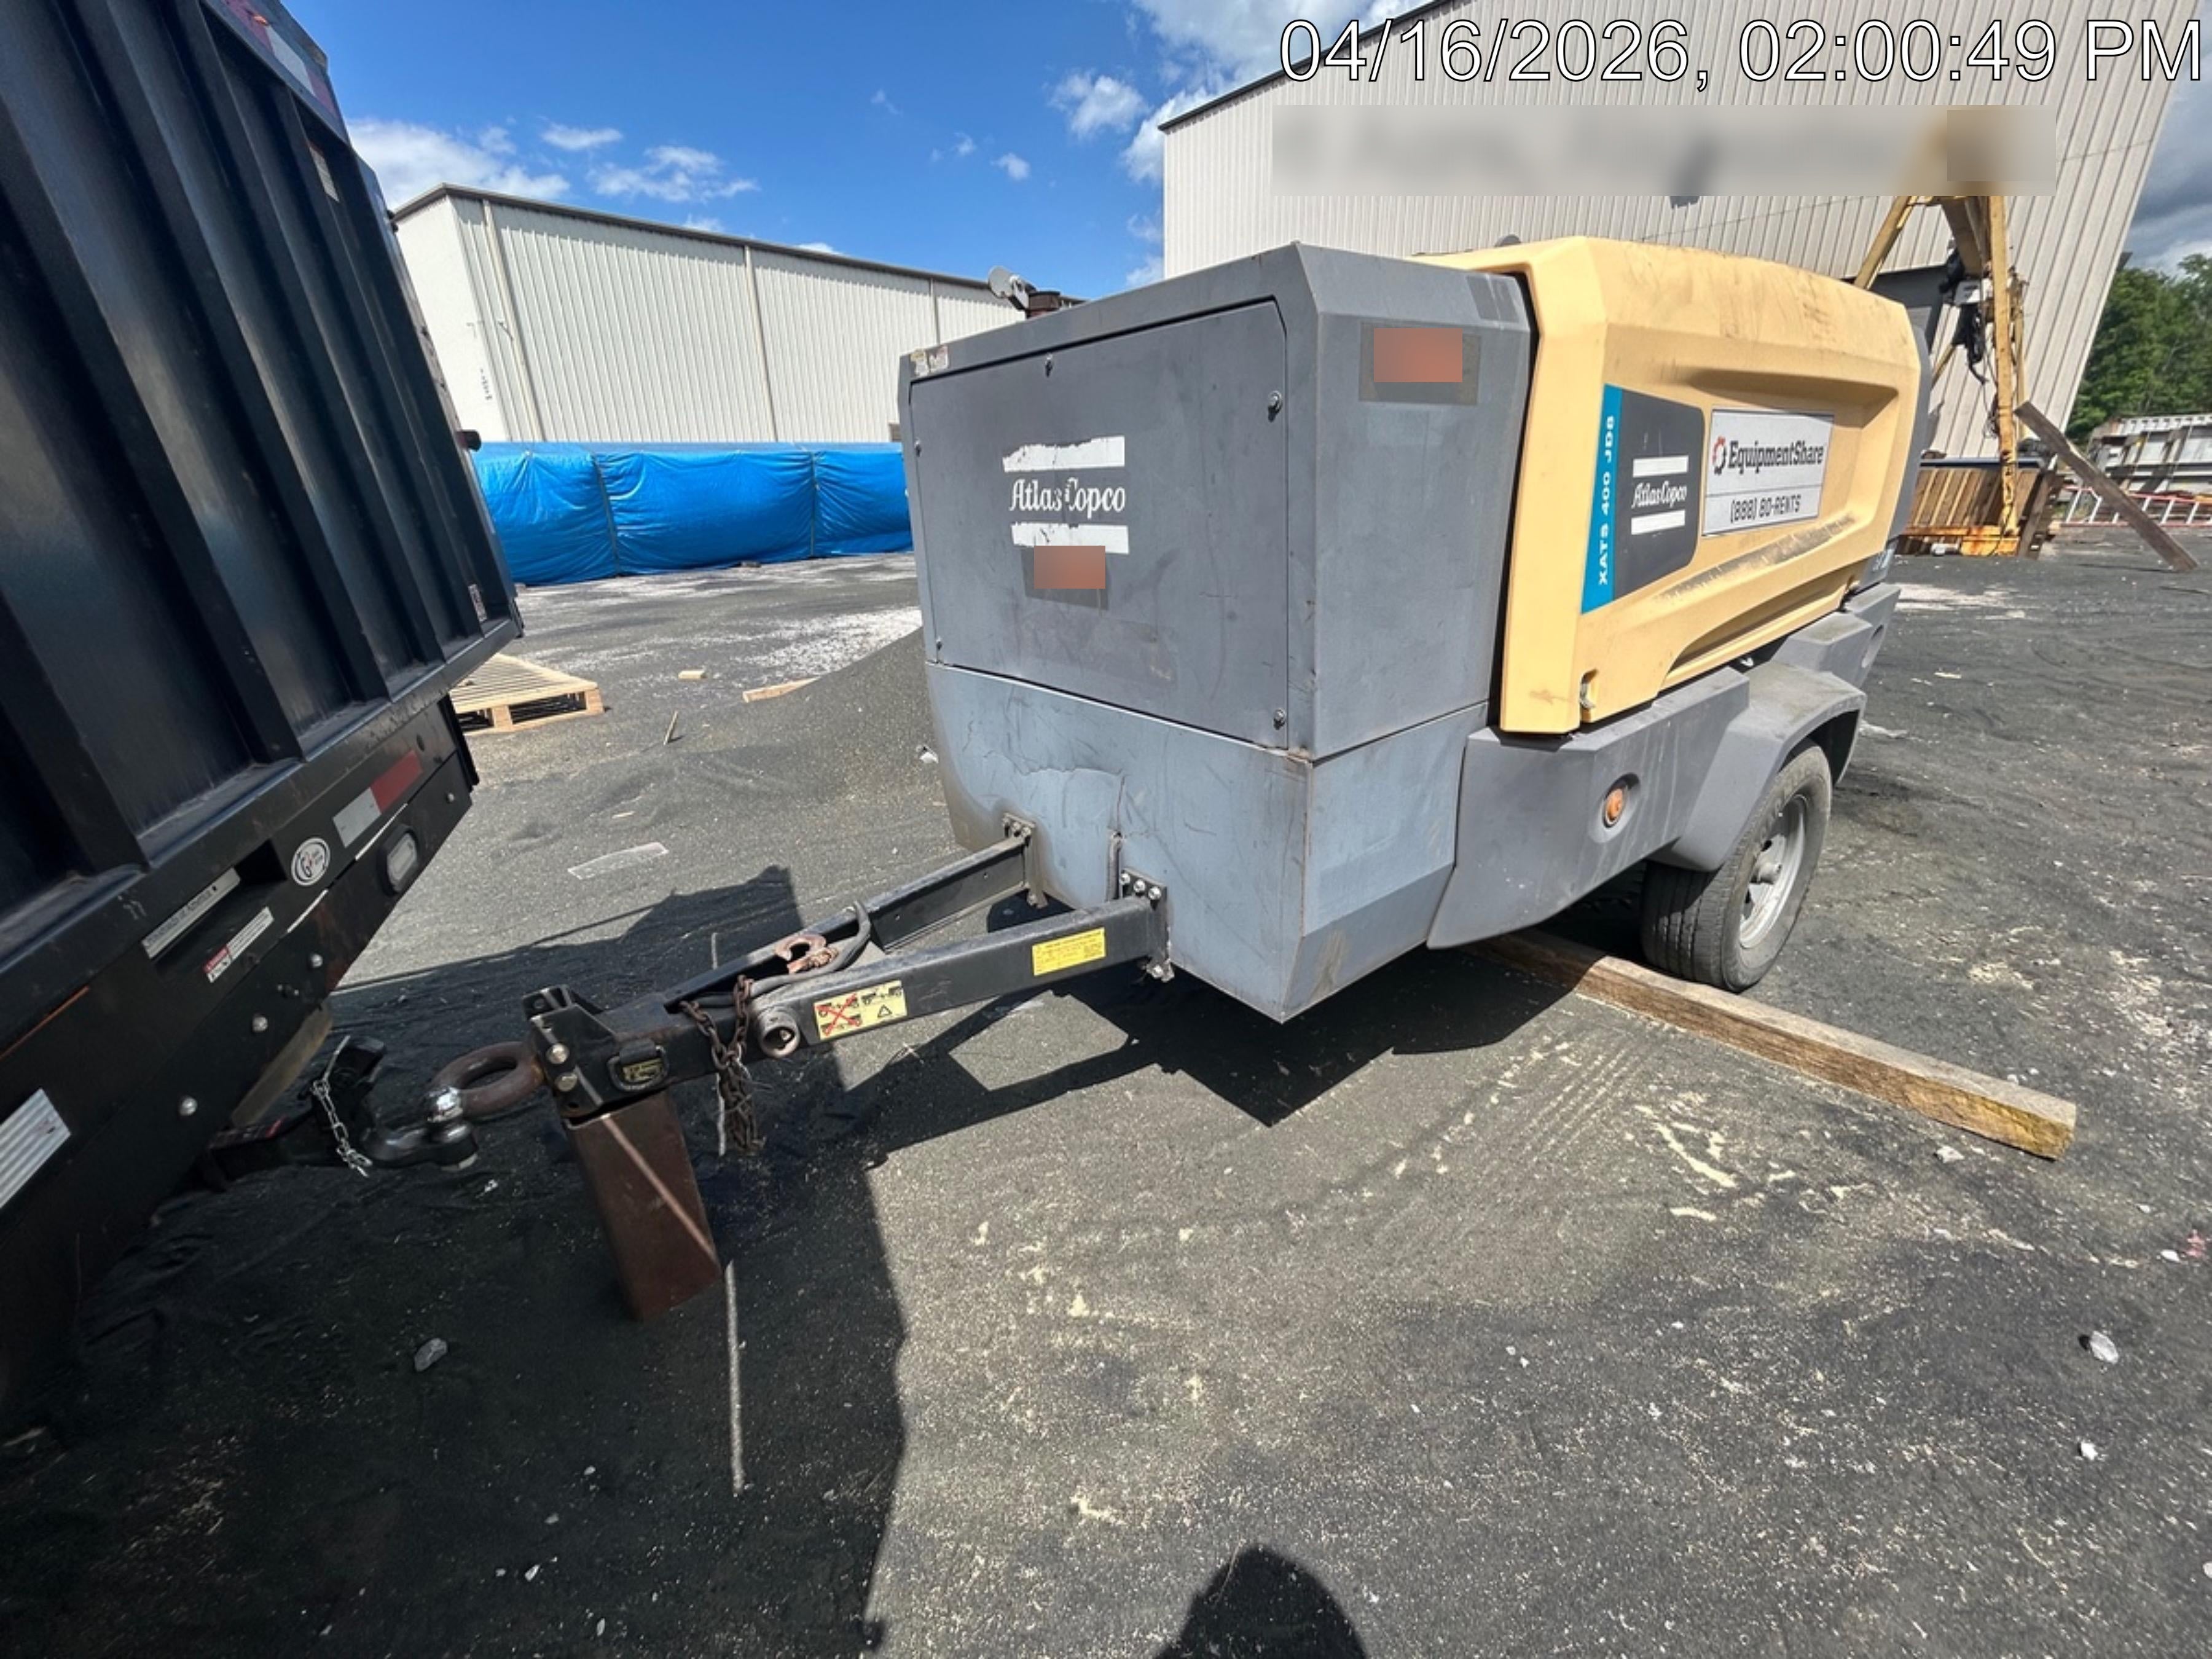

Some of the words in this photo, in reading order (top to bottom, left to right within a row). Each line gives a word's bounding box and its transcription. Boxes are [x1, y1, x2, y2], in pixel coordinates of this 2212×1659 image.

[1728, 440, 1824, 474] EquipmentShare
[1009, 479, 1062, 511] Atlas
[1064, 477, 1126, 519] Copco
[1601, 471, 1611, 516] 400
[1631, 482, 1660, 509] Atlas
[1661, 480, 1688, 508] Copco
[1730, 496, 1758, 523] (888)
[1759, 493, 1802, 518] 80-RENTS
[1599, 524, 1609, 586] XATS
